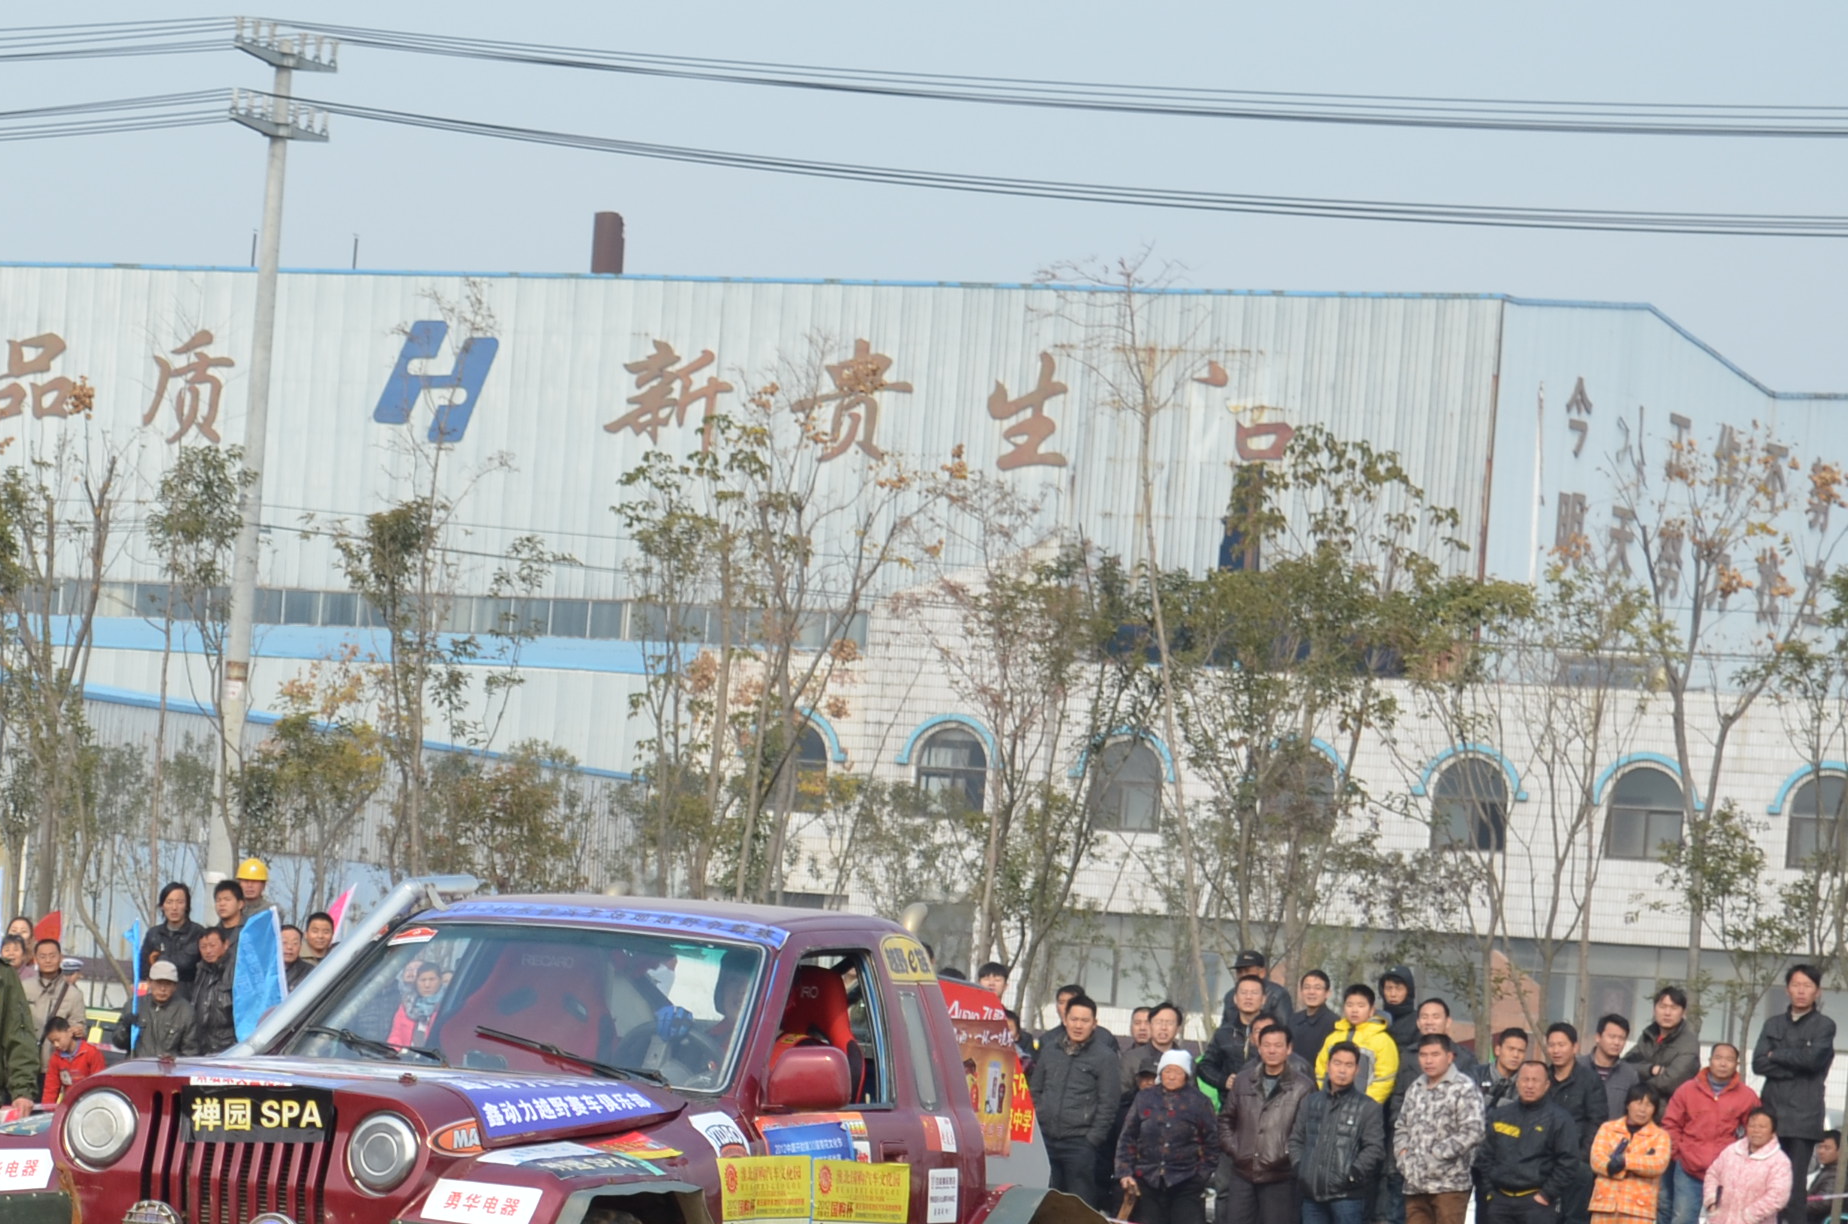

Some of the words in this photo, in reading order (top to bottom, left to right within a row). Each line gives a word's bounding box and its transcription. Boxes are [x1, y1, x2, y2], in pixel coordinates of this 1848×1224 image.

[602, 337, 1293, 472] 新贵生
[520, 954, 576, 969] RECARO
[190, 1096, 254, 1132] 禅园
[260, 1098, 324, 1129] SPA
[481, 1091, 653, 1128] 鑫动力越野赛车俱乐部
[442, 1190, 521, 1217] 勇华电器
